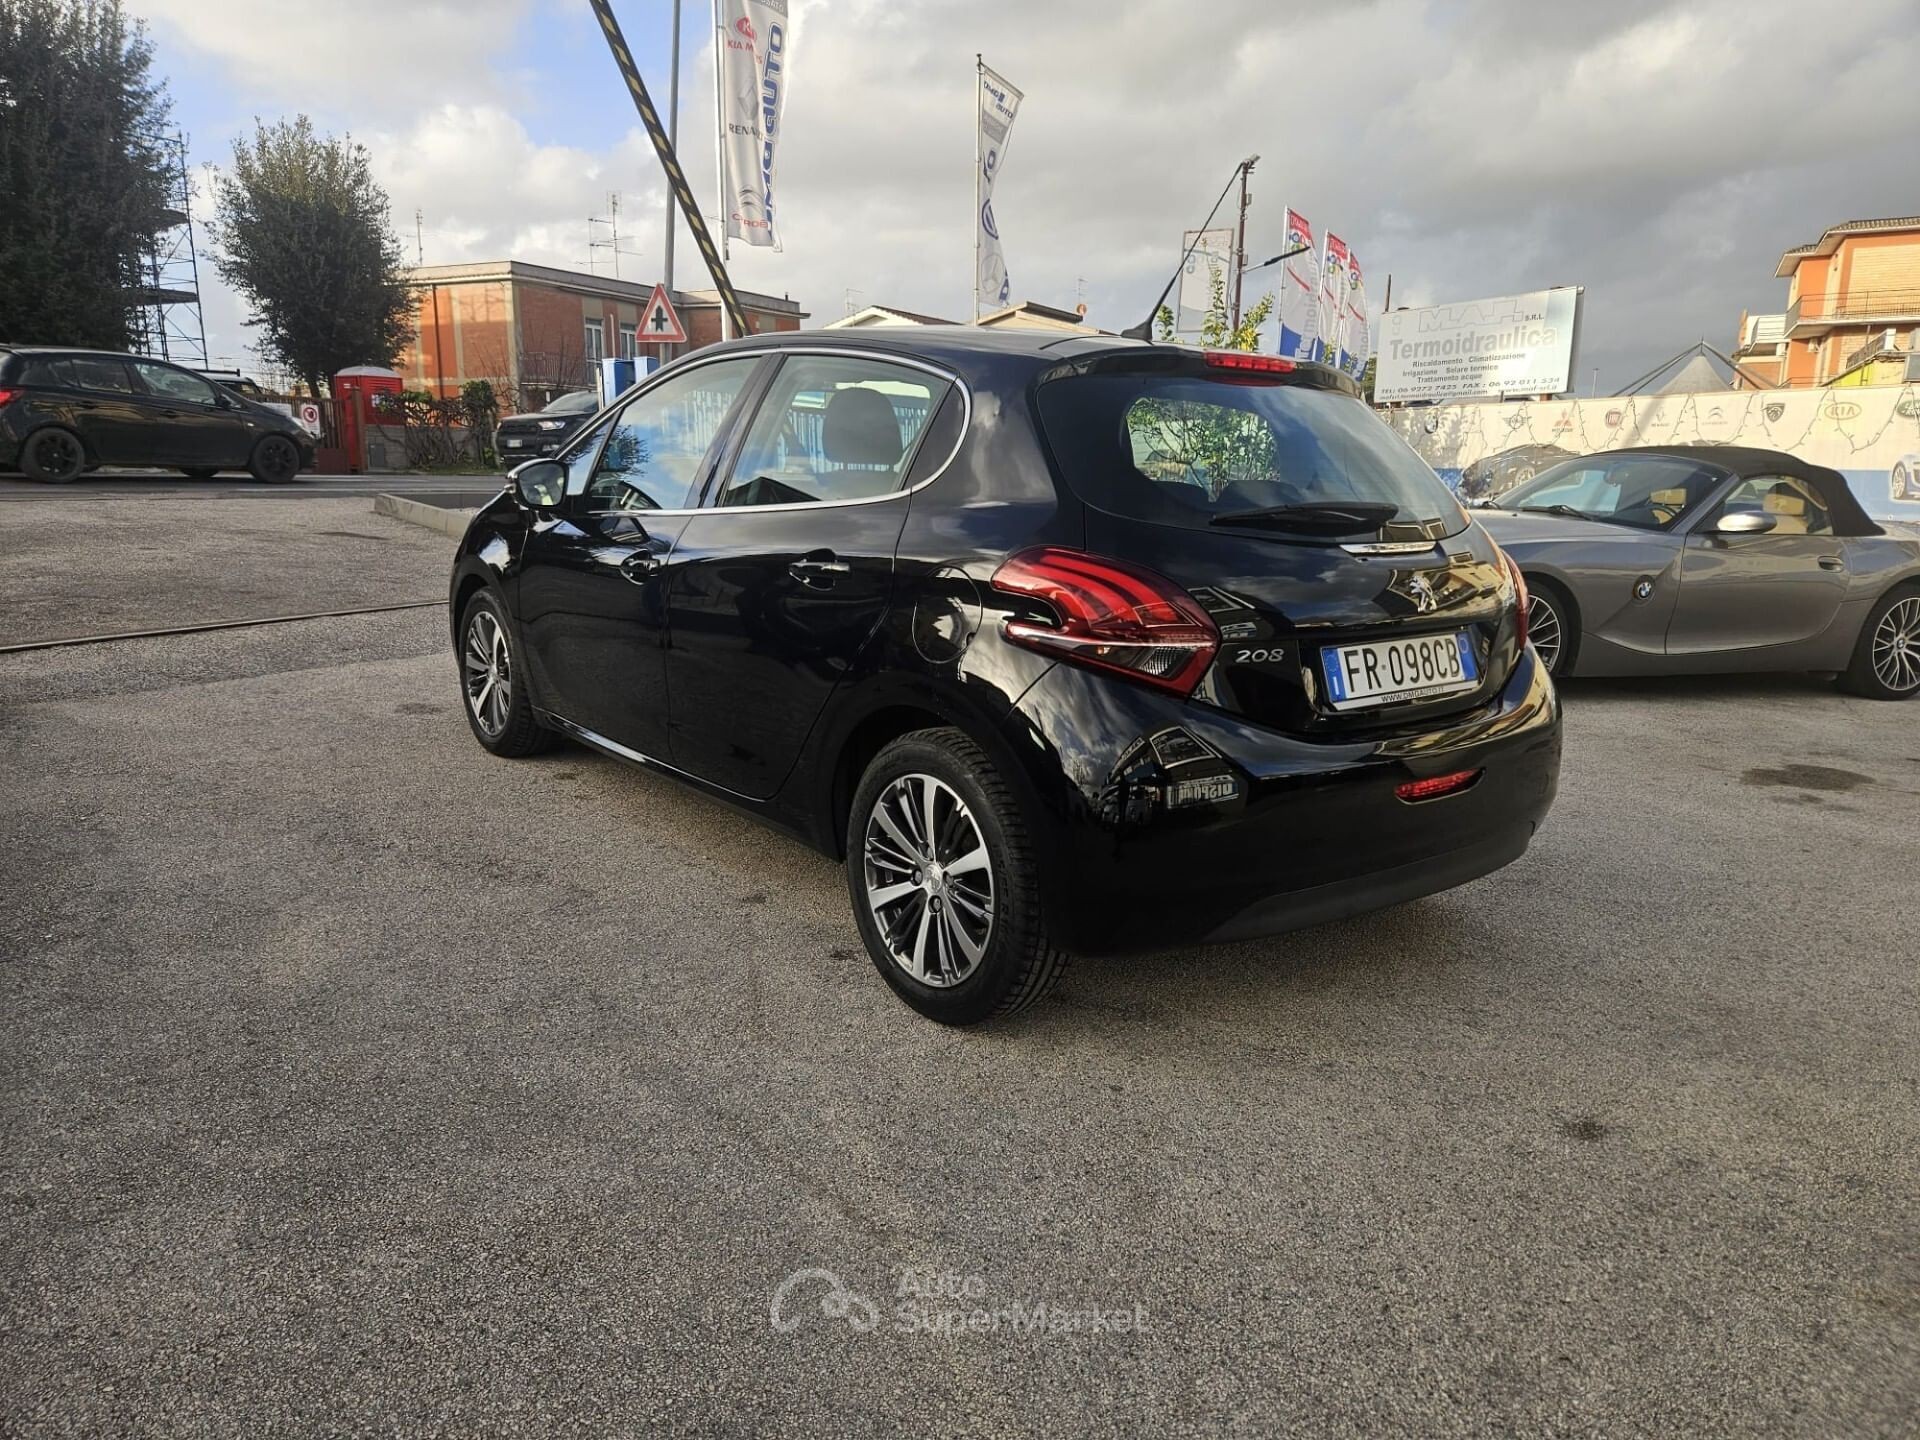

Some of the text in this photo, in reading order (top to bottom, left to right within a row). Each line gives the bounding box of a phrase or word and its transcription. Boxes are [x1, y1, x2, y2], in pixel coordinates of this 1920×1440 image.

[727, 39, 743, 50] KIA
[1389, 325, 1558, 360] Termoidraulica
[1412, 352, 1526, 368] Riscaldamento Climatizzazione
[1402, 364, 1499, 378] Irrigazione Solare termico
[1417, 373, 1483, 384] Trattamento acque
[1830, 406, 1856, 416] KIA
[1235, 648, 1285, 664] 208
